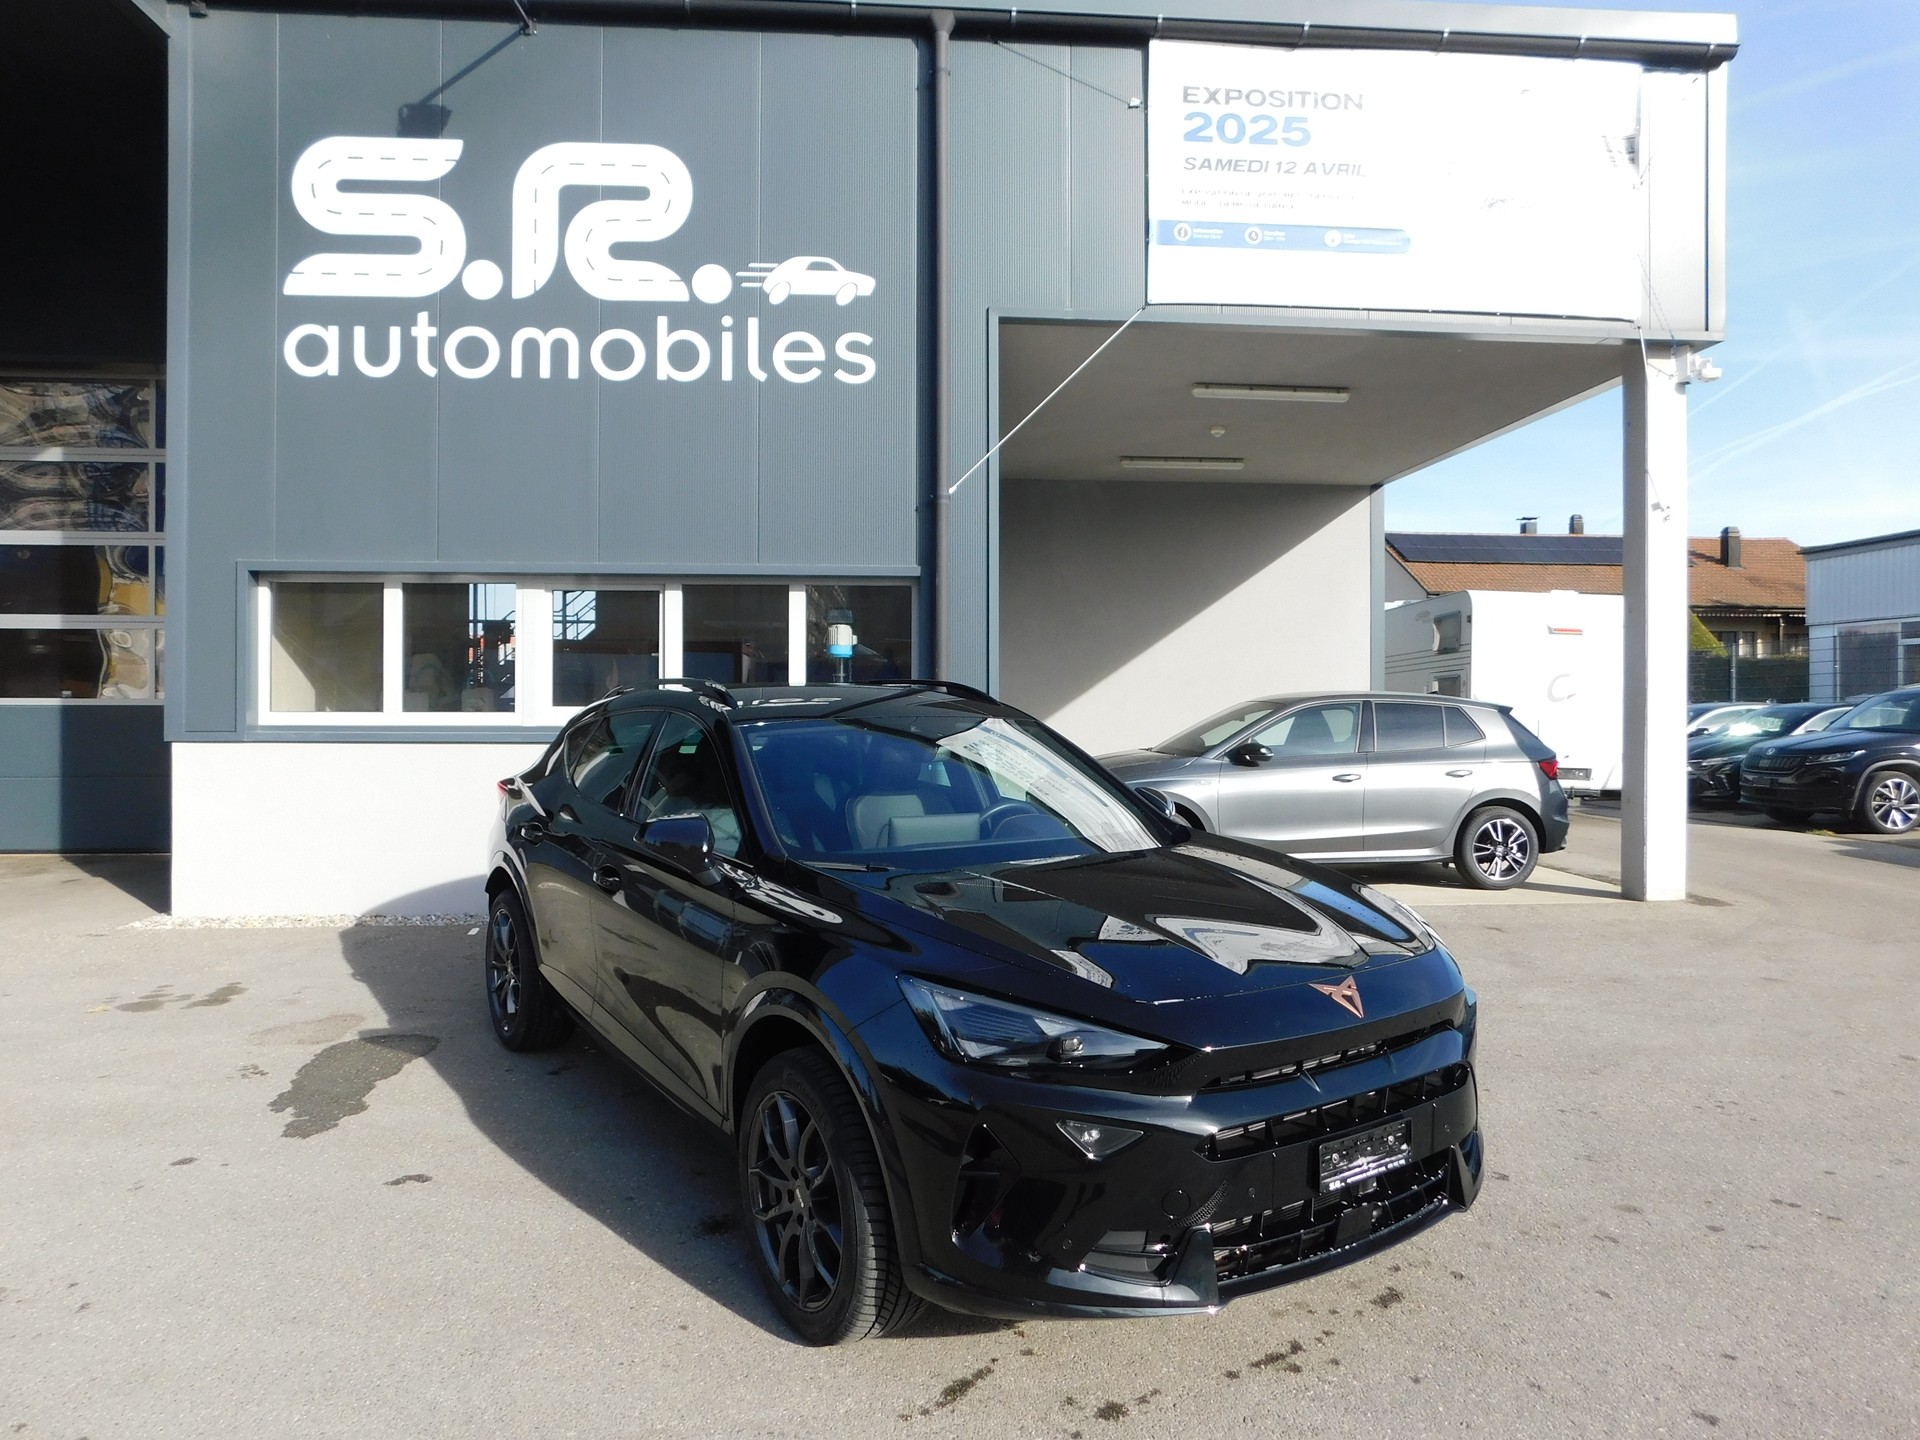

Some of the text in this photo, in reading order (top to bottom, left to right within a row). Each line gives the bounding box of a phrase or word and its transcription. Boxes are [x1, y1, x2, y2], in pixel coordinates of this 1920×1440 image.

[1182, 85, 1364, 110] EXPOSITION
[1183, 111, 1312, 148] 2025
[1183, 157, 1367, 177] SAMEDI 12 AVRIL
[282, 135, 733, 303] S.R.
[283, 311, 877, 385] automobiles
